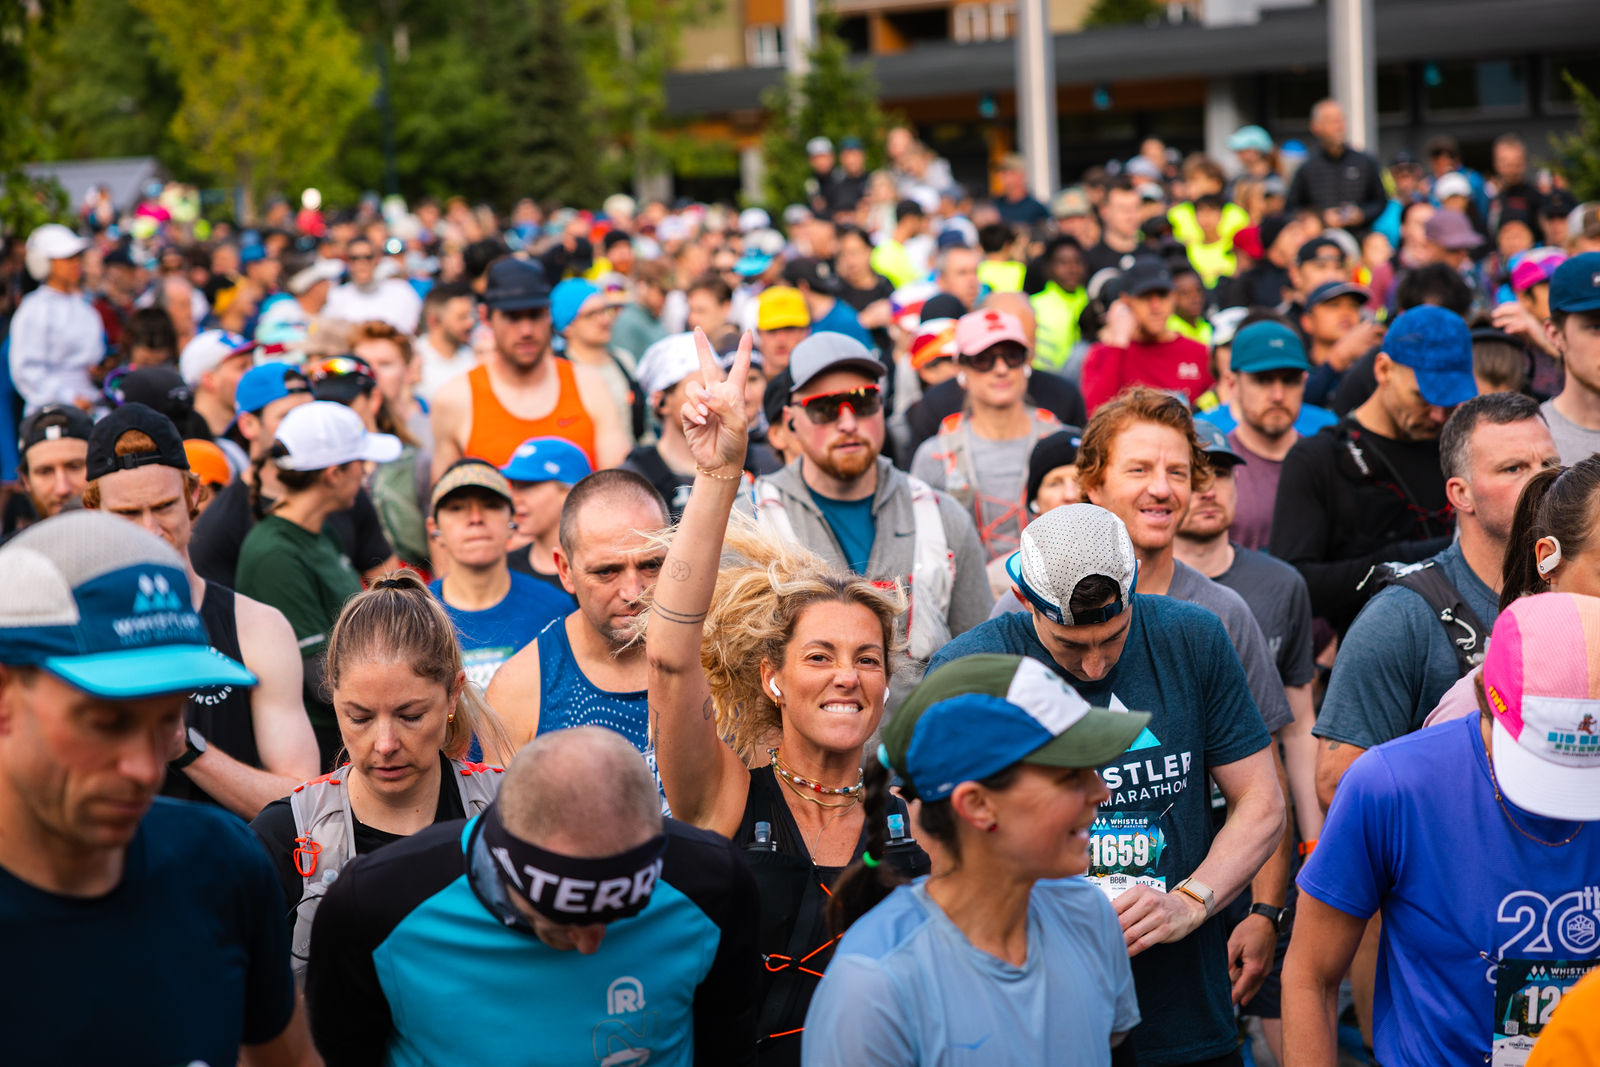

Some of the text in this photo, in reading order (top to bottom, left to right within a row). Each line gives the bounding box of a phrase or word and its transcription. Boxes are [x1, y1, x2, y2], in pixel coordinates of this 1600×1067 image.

[1094, 751, 1192, 790] STLER
[1100, 777, 1188, 808] MARATHON
[1089, 834, 1149, 867] 1659
